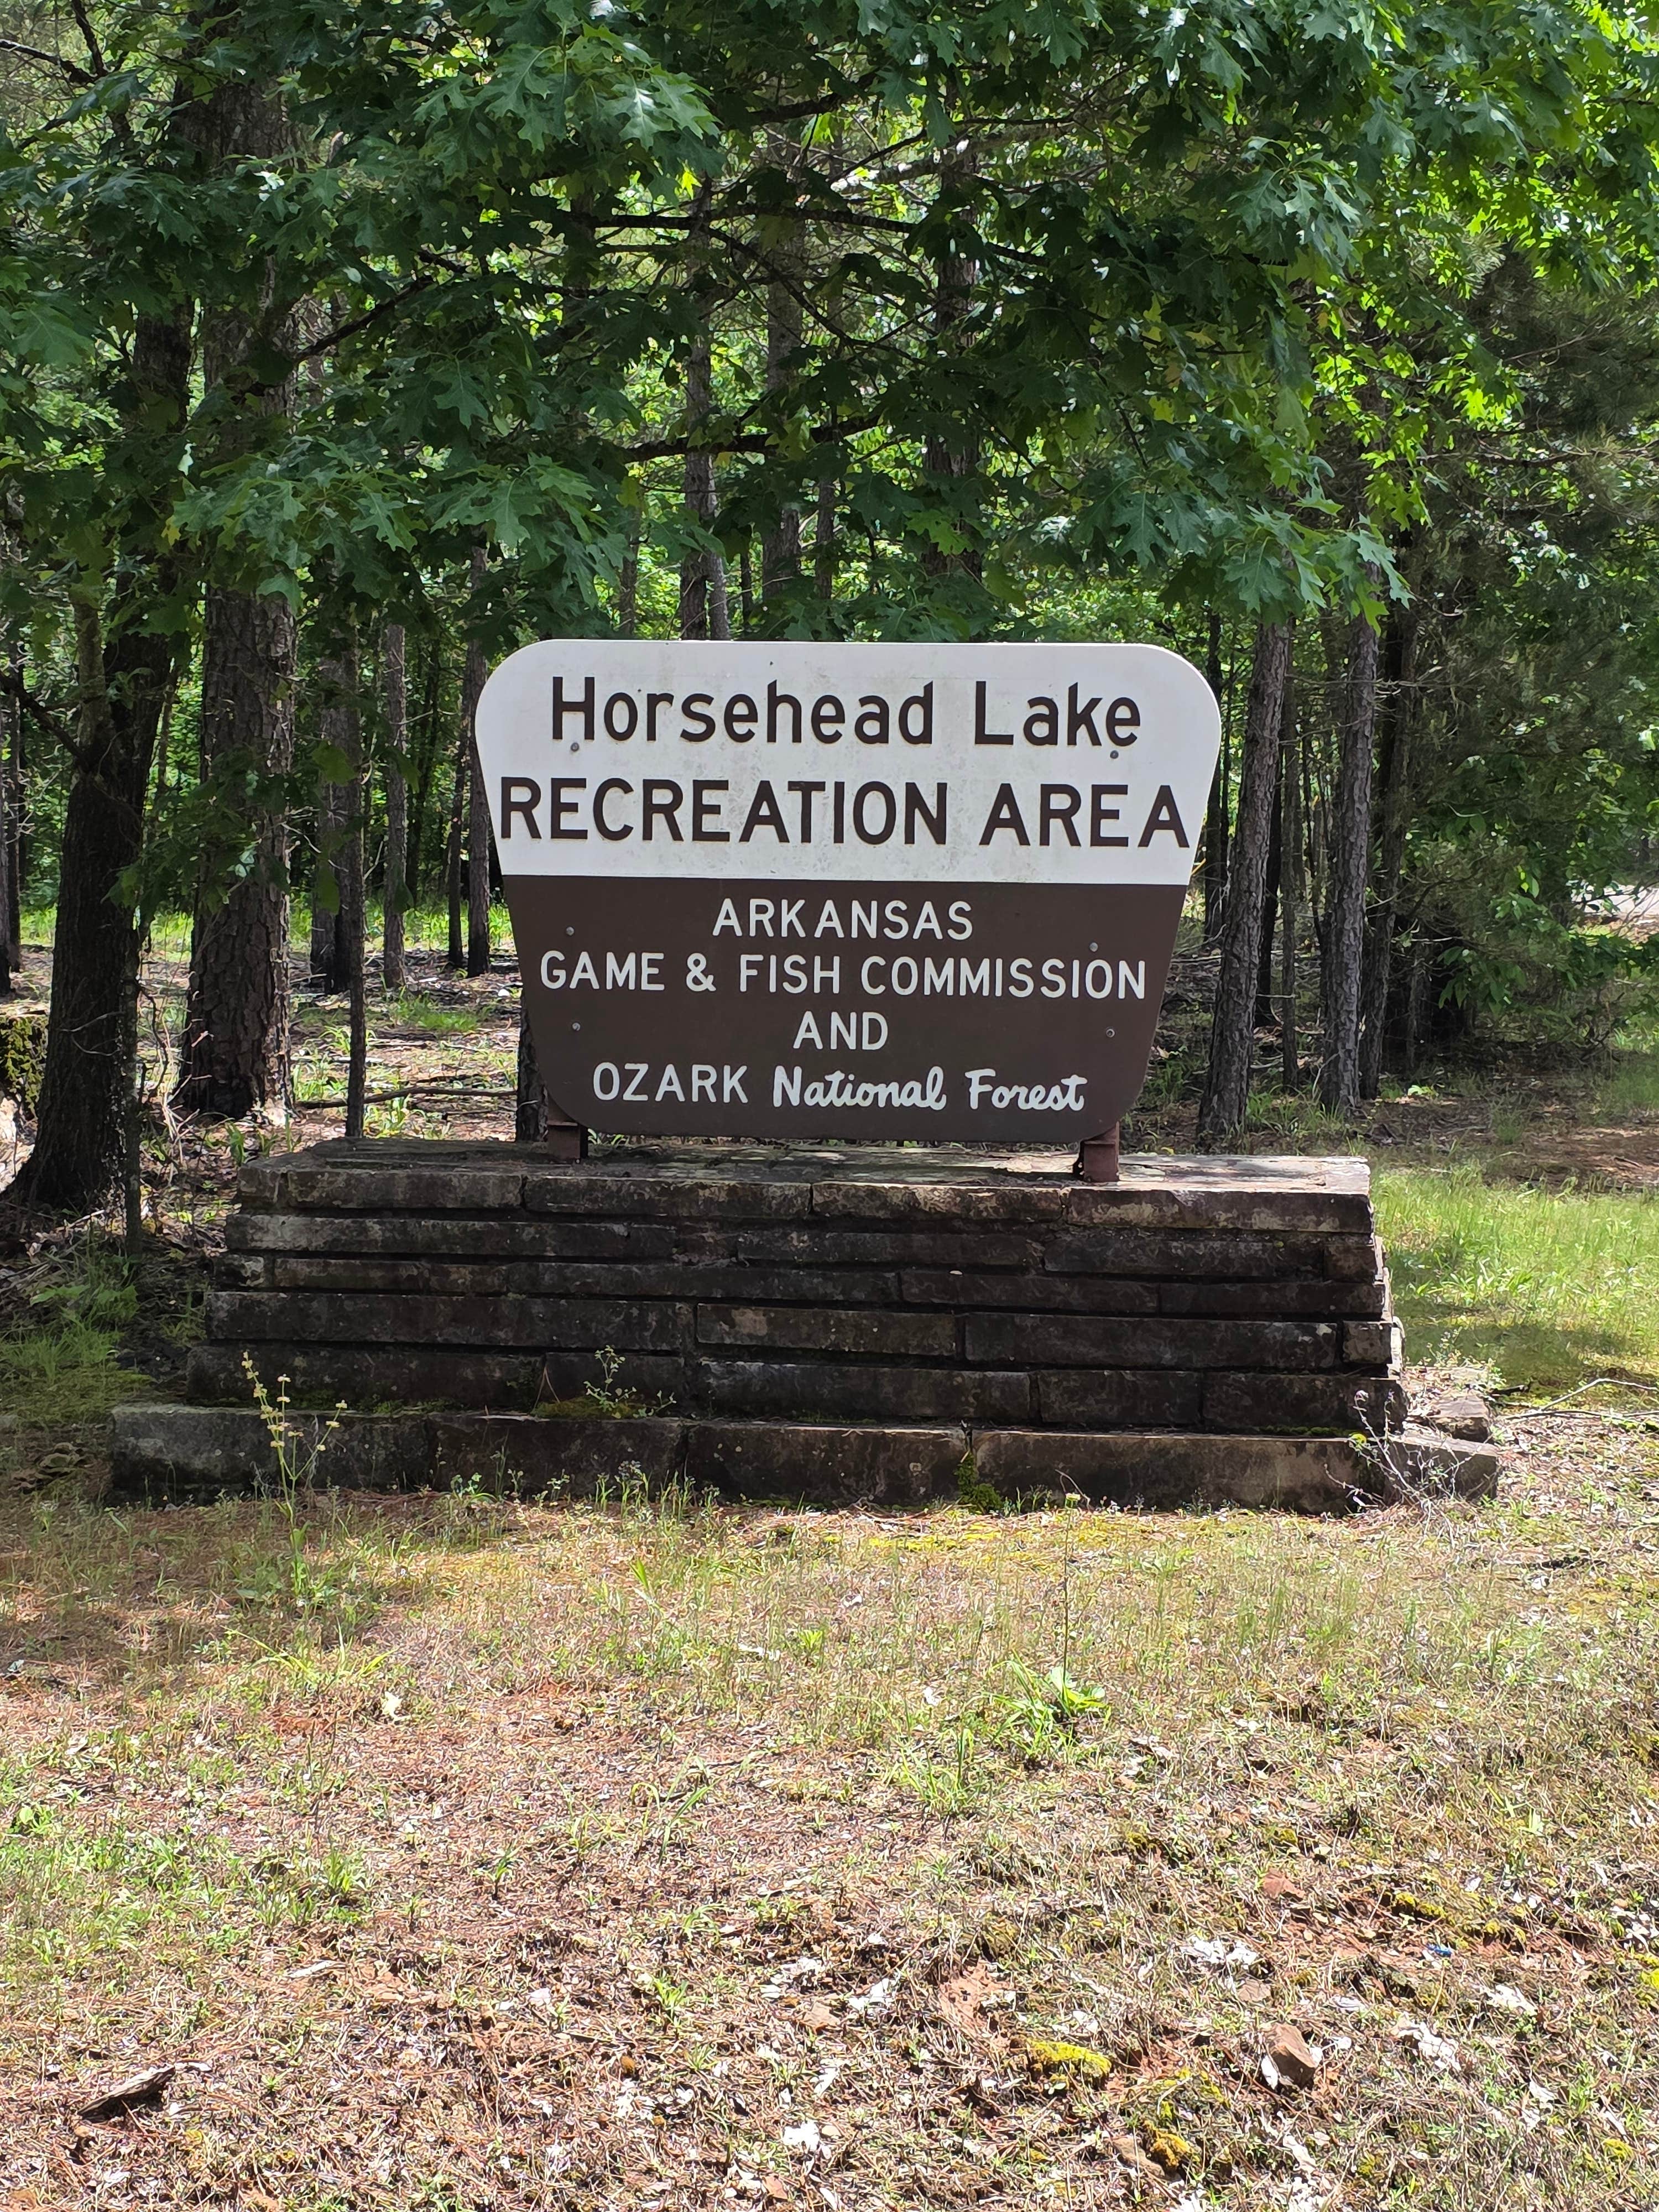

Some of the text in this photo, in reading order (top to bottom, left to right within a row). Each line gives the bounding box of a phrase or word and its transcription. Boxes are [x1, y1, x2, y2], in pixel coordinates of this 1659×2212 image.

[552, 676, 1141, 747] Horsehead Lake
[500, 776, 1190, 848] RECREATION AREA
[712, 898, 973, 940] ARKANSAS
[540, 950, 1145, 999] GAME & FISH COMMISSION
[793, 1011, 888, 1050] AND
[593, 1062, 1088, 1111] OZARK National Forest
